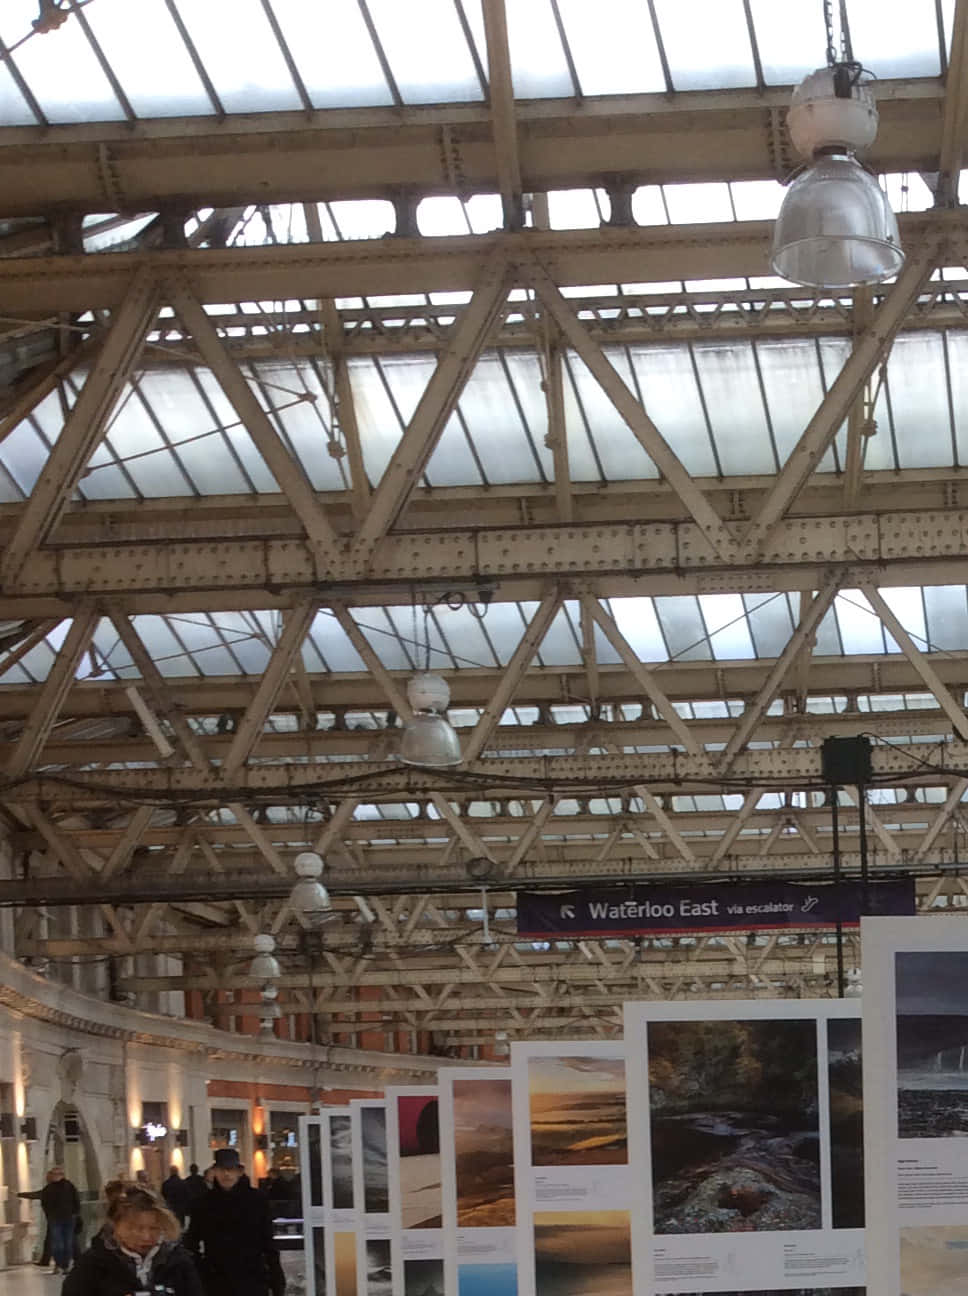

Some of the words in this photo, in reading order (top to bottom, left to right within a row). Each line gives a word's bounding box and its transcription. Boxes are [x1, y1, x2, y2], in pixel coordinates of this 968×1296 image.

[588, 901, 674, 920] Waterloo
[680, 899, 719, 917] East
[727, 904, 743, 915] via
[745, 901, 794, 914] escalator
